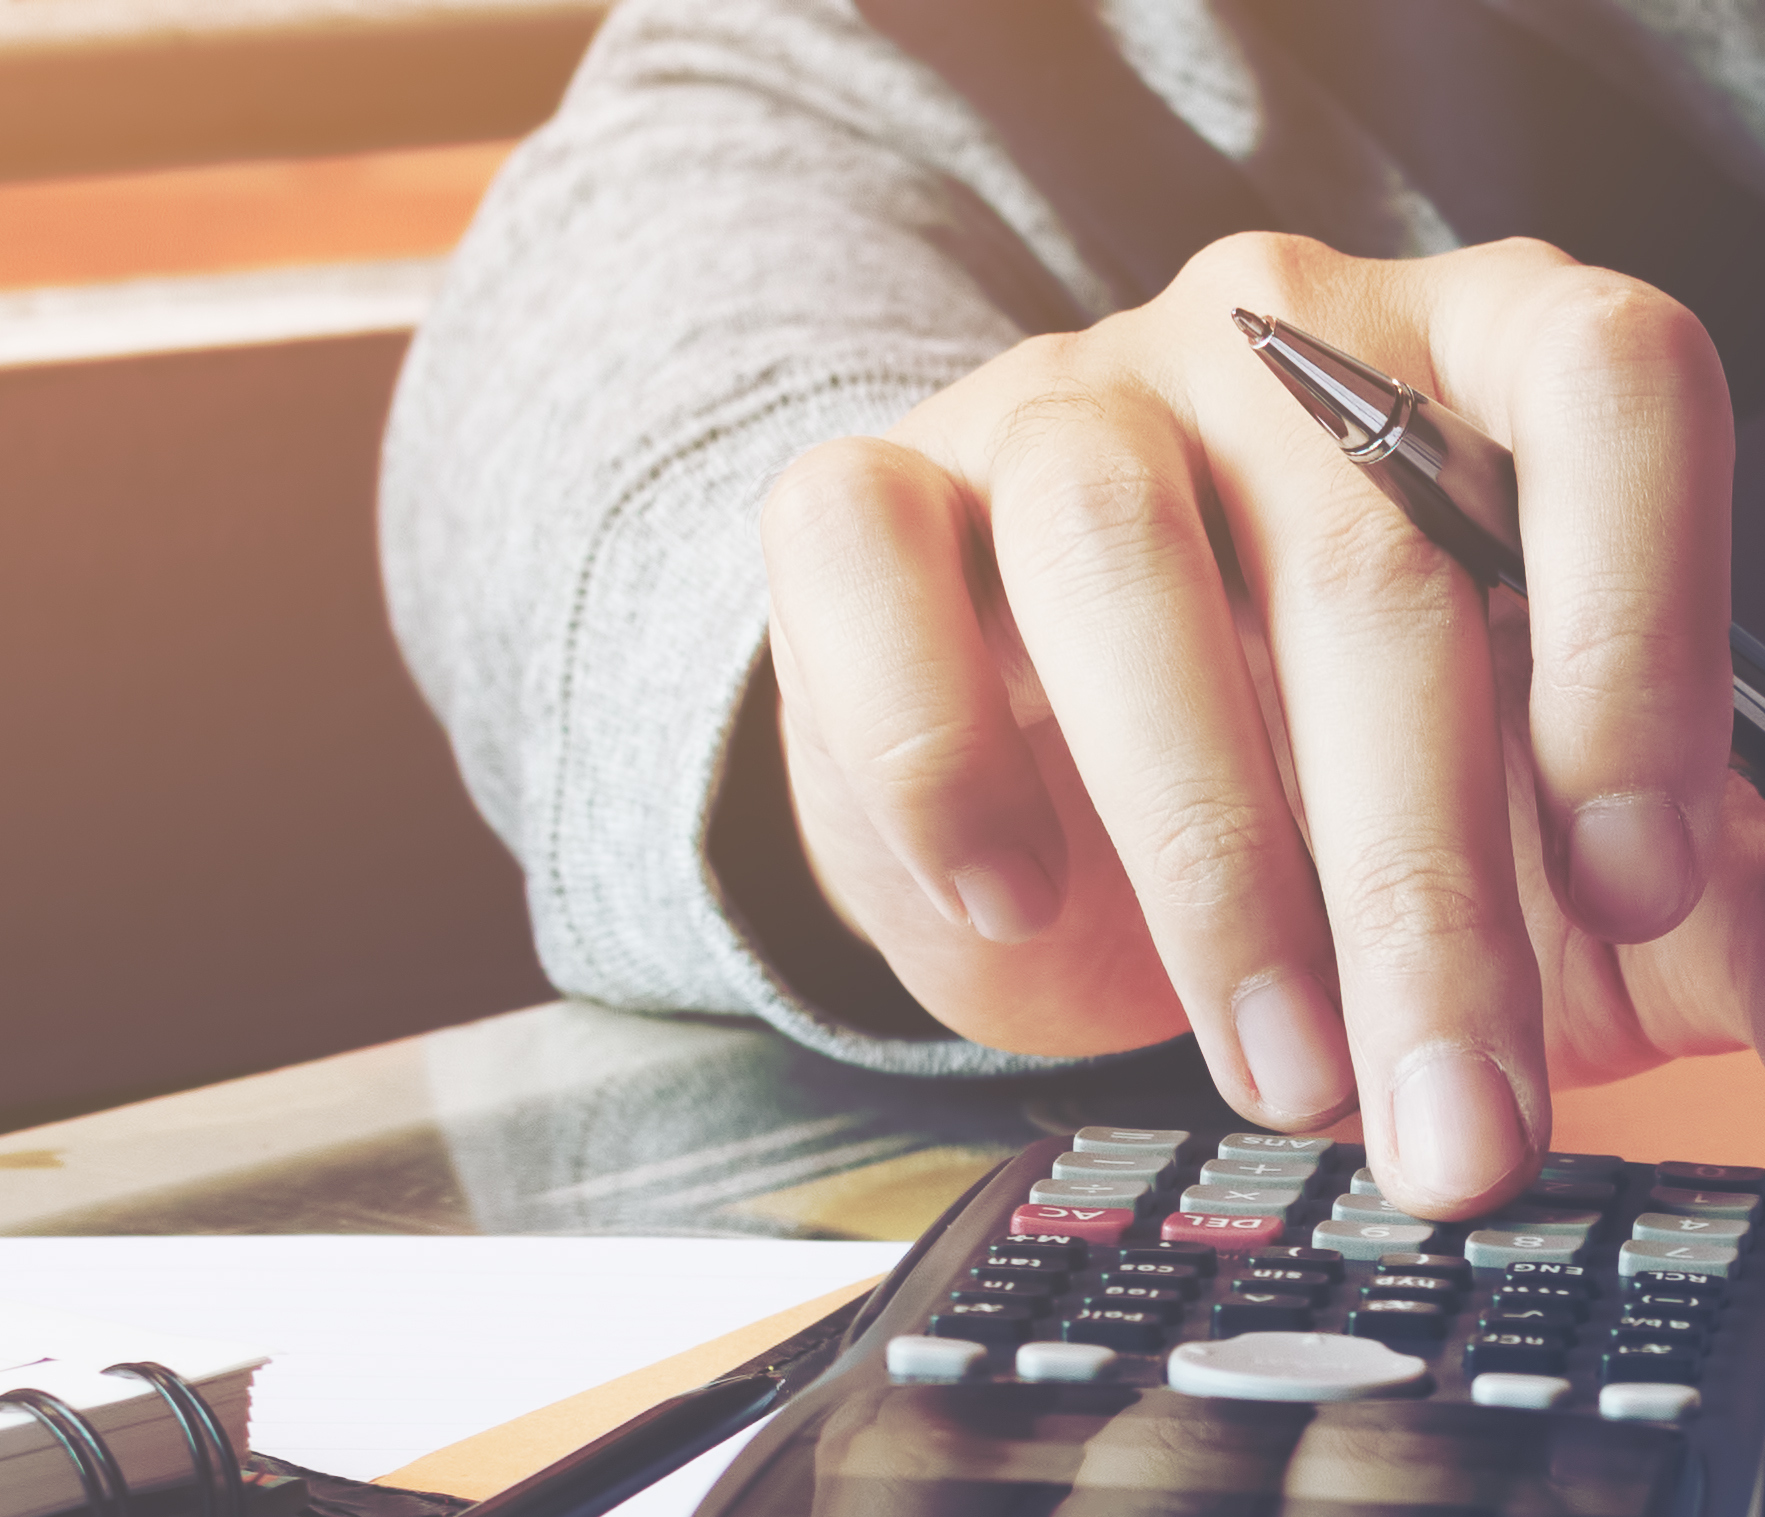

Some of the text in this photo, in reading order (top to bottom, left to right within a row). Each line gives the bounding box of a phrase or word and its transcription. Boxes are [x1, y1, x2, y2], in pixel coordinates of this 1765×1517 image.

[1242, 1137, 1315, 1149] Ans
[1038, 1207, 1104, 1219] AC
[1184, 1214, 1261, 1228] DEL
[1679, 1218, 1709, 1230] 4
[1360, 1226, 1390, 1237] 9
[1007, 1234, 1070, 1244] M+
[1513, 1236, 1544, 1247] 8
[1666, 1247, 1692, 1258] 7
[988, 1258, 1041, 1268] tan
[1120, 1264, 1173, 1273] cos
[1514, 1263, 1583, 1275] ENG
[1253, 1269, 1302, 1281] sin
[1648, 1271, 1707, 1283] RCL
[1375, 1276, 1436, 1290] hyp
[1105, 1286, 1159, 1298] log
